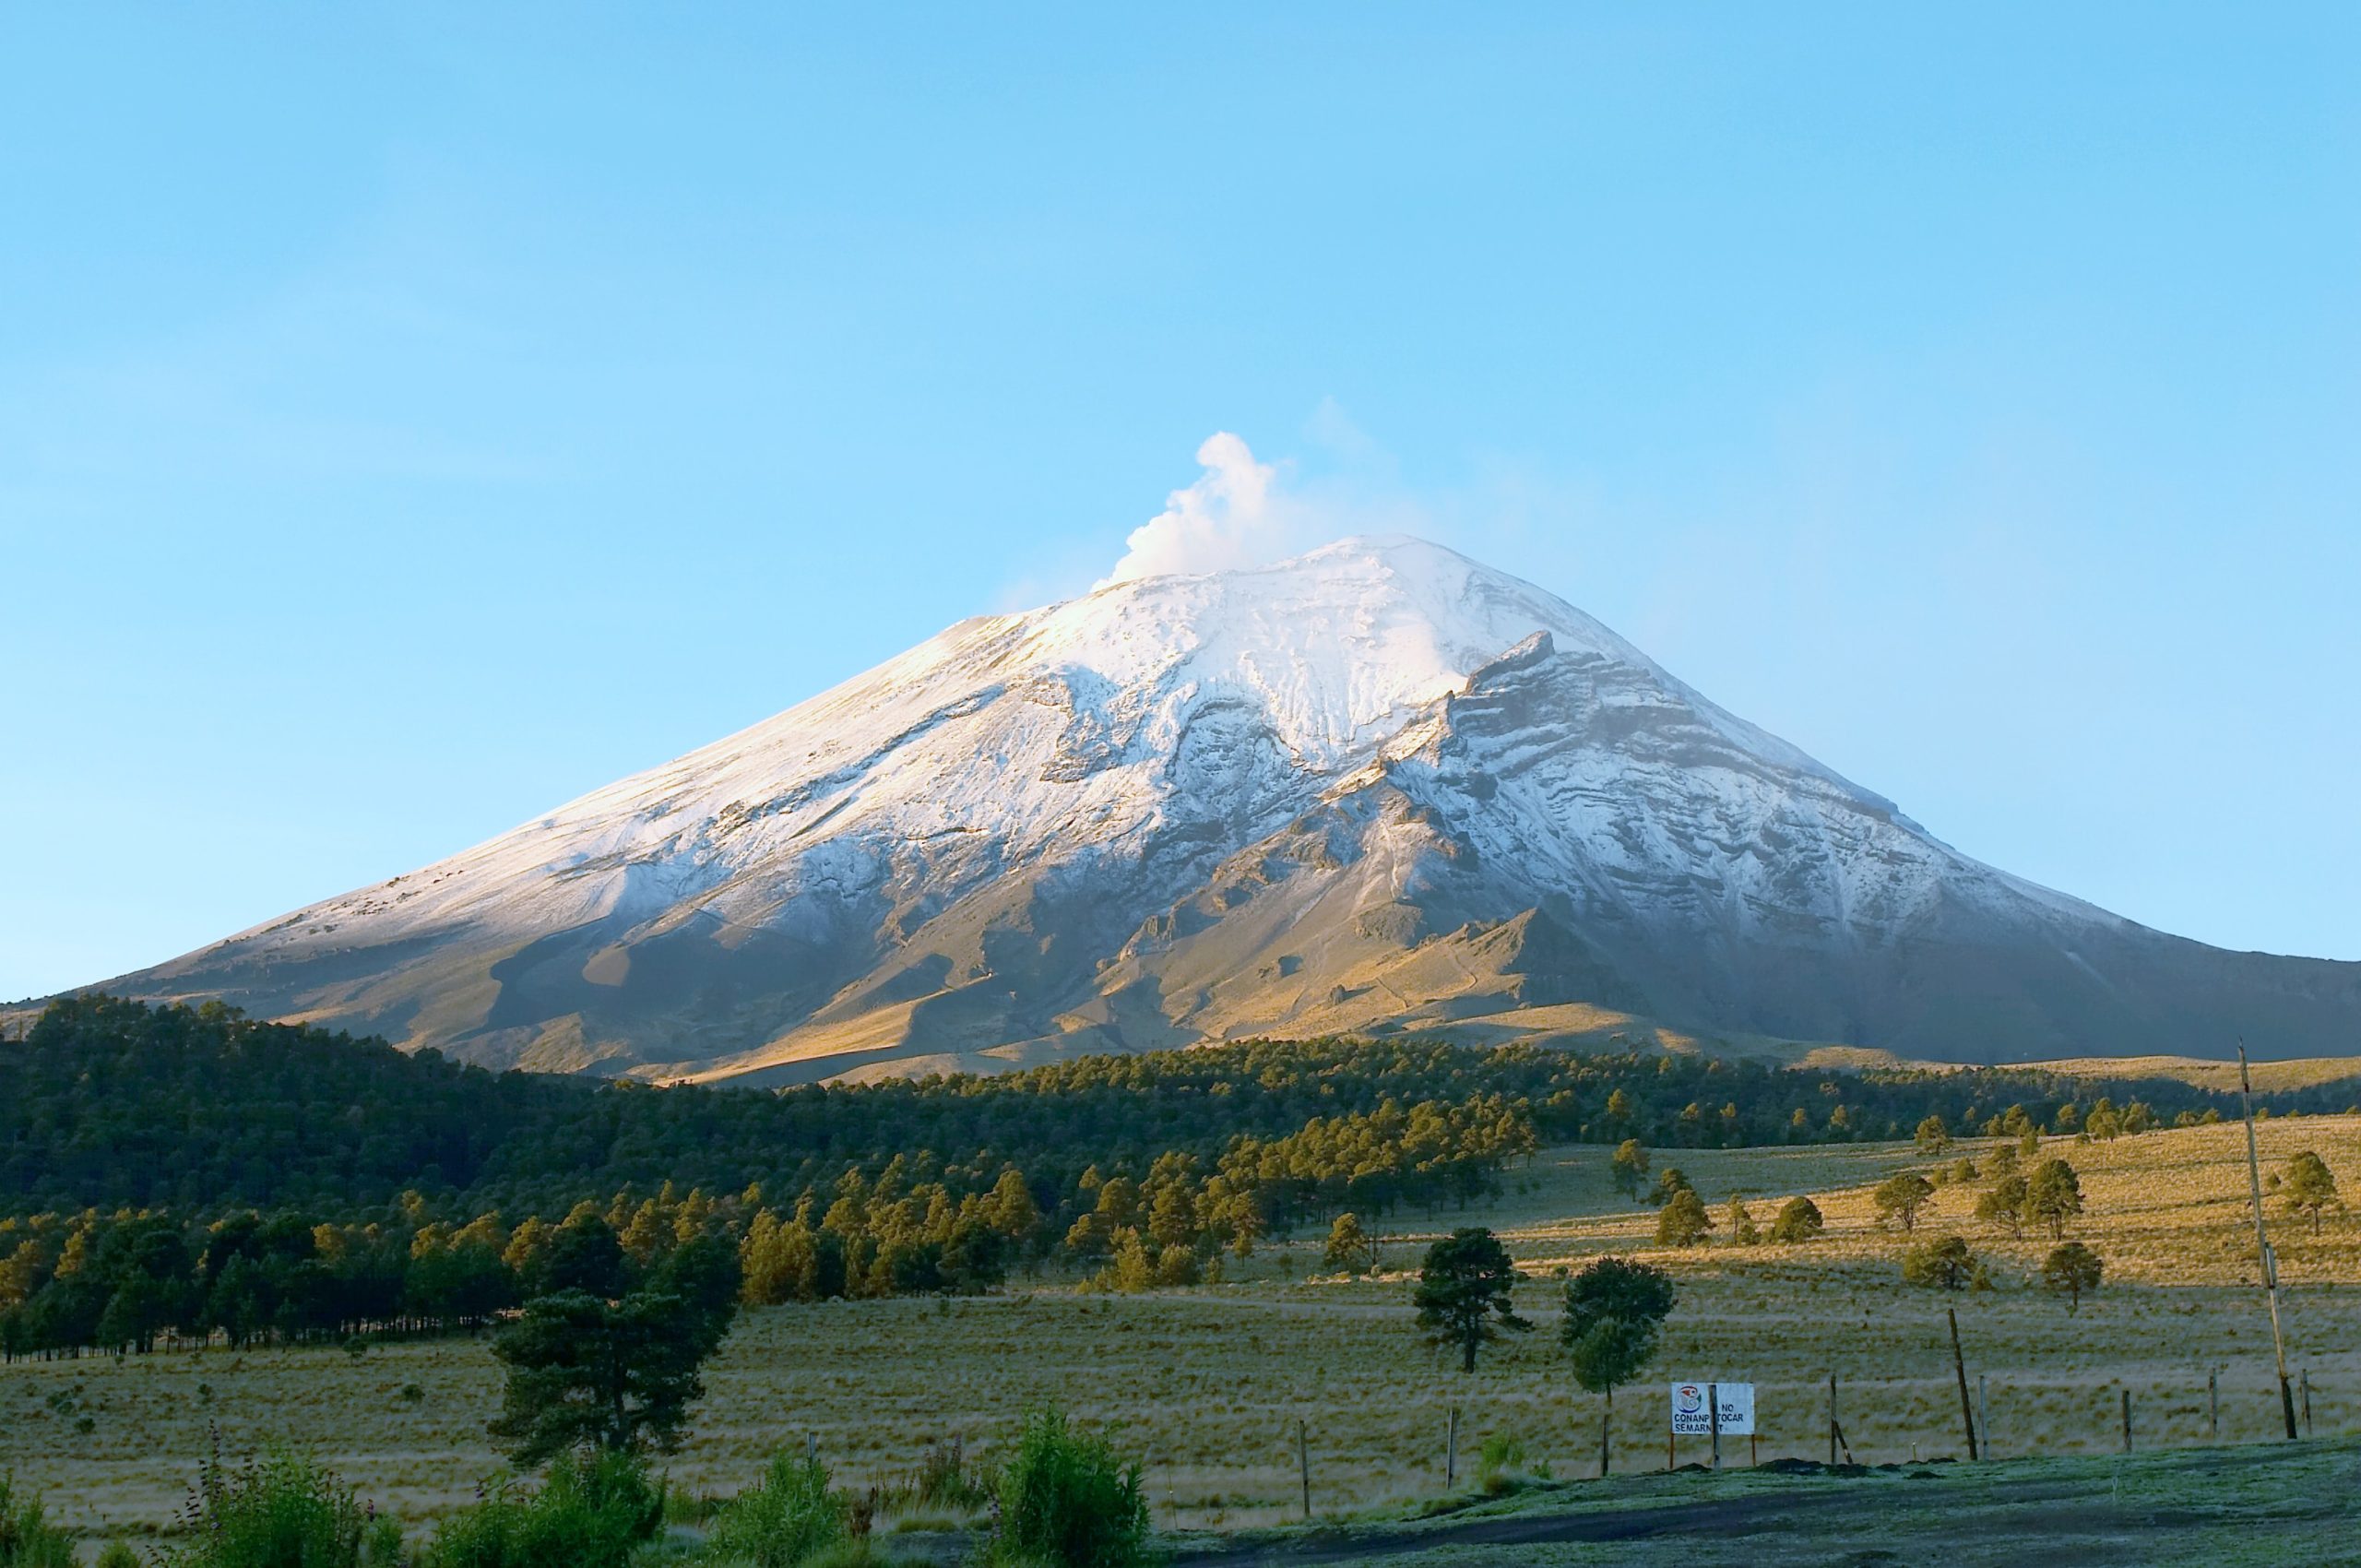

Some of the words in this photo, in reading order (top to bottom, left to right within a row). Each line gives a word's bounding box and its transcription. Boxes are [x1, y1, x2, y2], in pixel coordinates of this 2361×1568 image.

[1674, 1413, 1710, 1422] CONANP
[1716, 1413, 1743, 1421] TOCAR
[1675, 1423, 1724, 1431] SEMARNT
